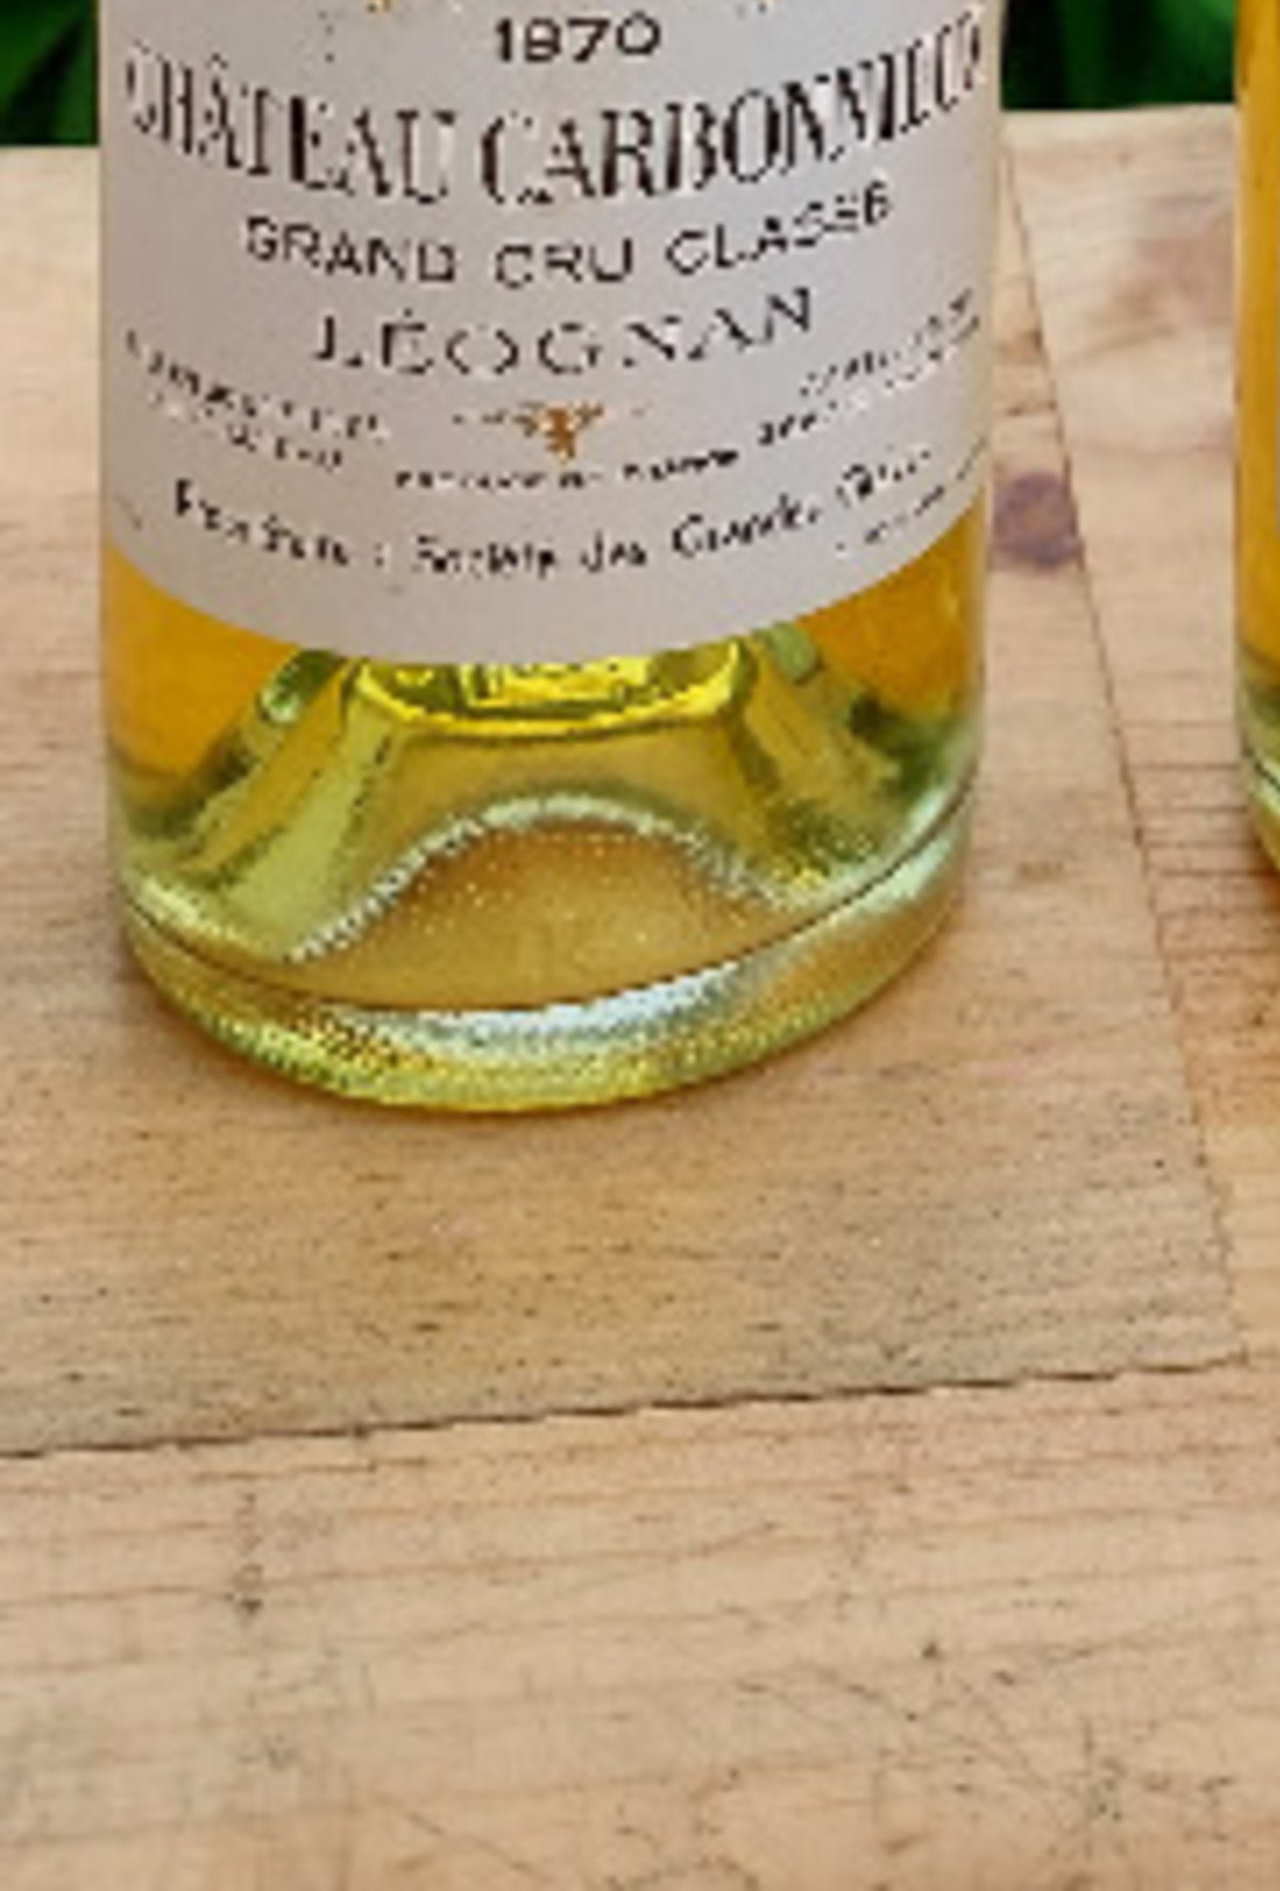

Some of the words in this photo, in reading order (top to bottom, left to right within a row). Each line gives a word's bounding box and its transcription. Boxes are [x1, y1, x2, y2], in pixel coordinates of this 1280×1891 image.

[246, 215, 456, 284] GRAND
[496, 238, 633, 291] CRU
[314, 286, 812, 377] LÉOGNAN
